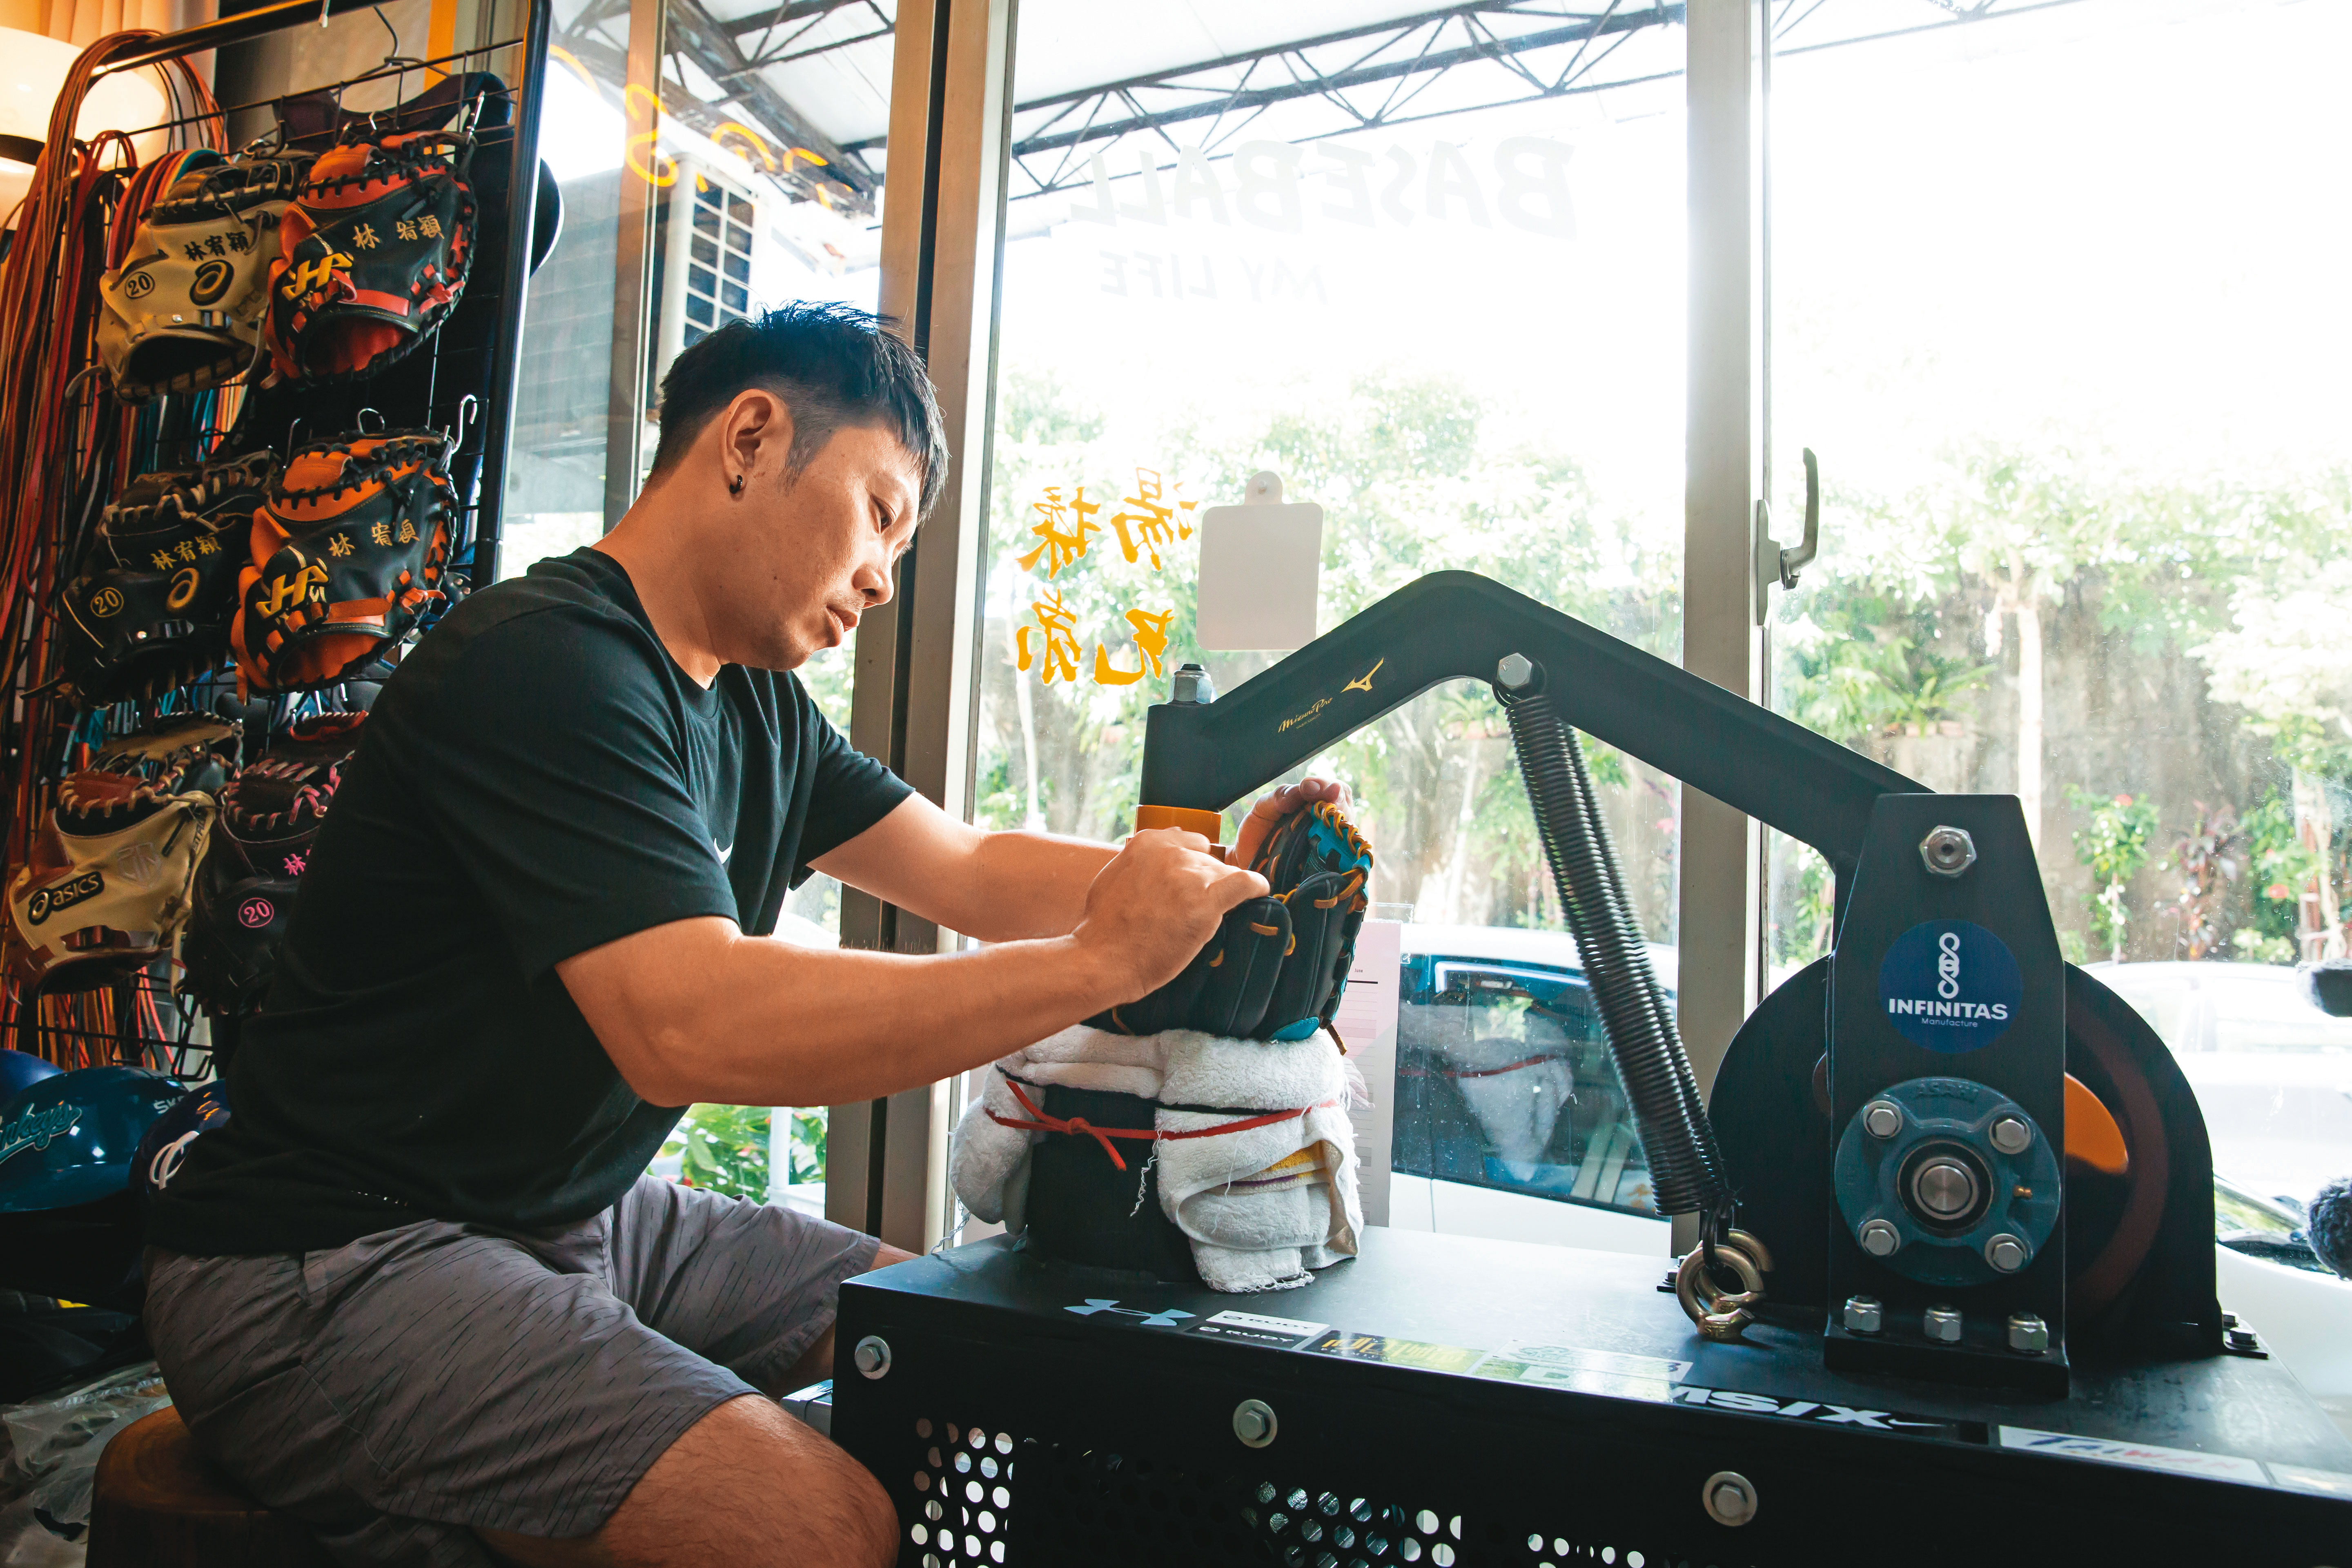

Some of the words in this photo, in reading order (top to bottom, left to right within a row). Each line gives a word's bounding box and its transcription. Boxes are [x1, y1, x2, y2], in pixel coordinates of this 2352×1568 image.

[128, 275, 151, 296] 20
[94, 591, 119, 614] 20
[244, 902, 270, 924] 20
[1889, 998, 2009, 1020] INFINITAS
[1921, 1017, 1978, 1027] Manufacture
[1249, 1319, 1315, 1329] RUDY
[1226, 1330, 1295, 1343] RUDY
